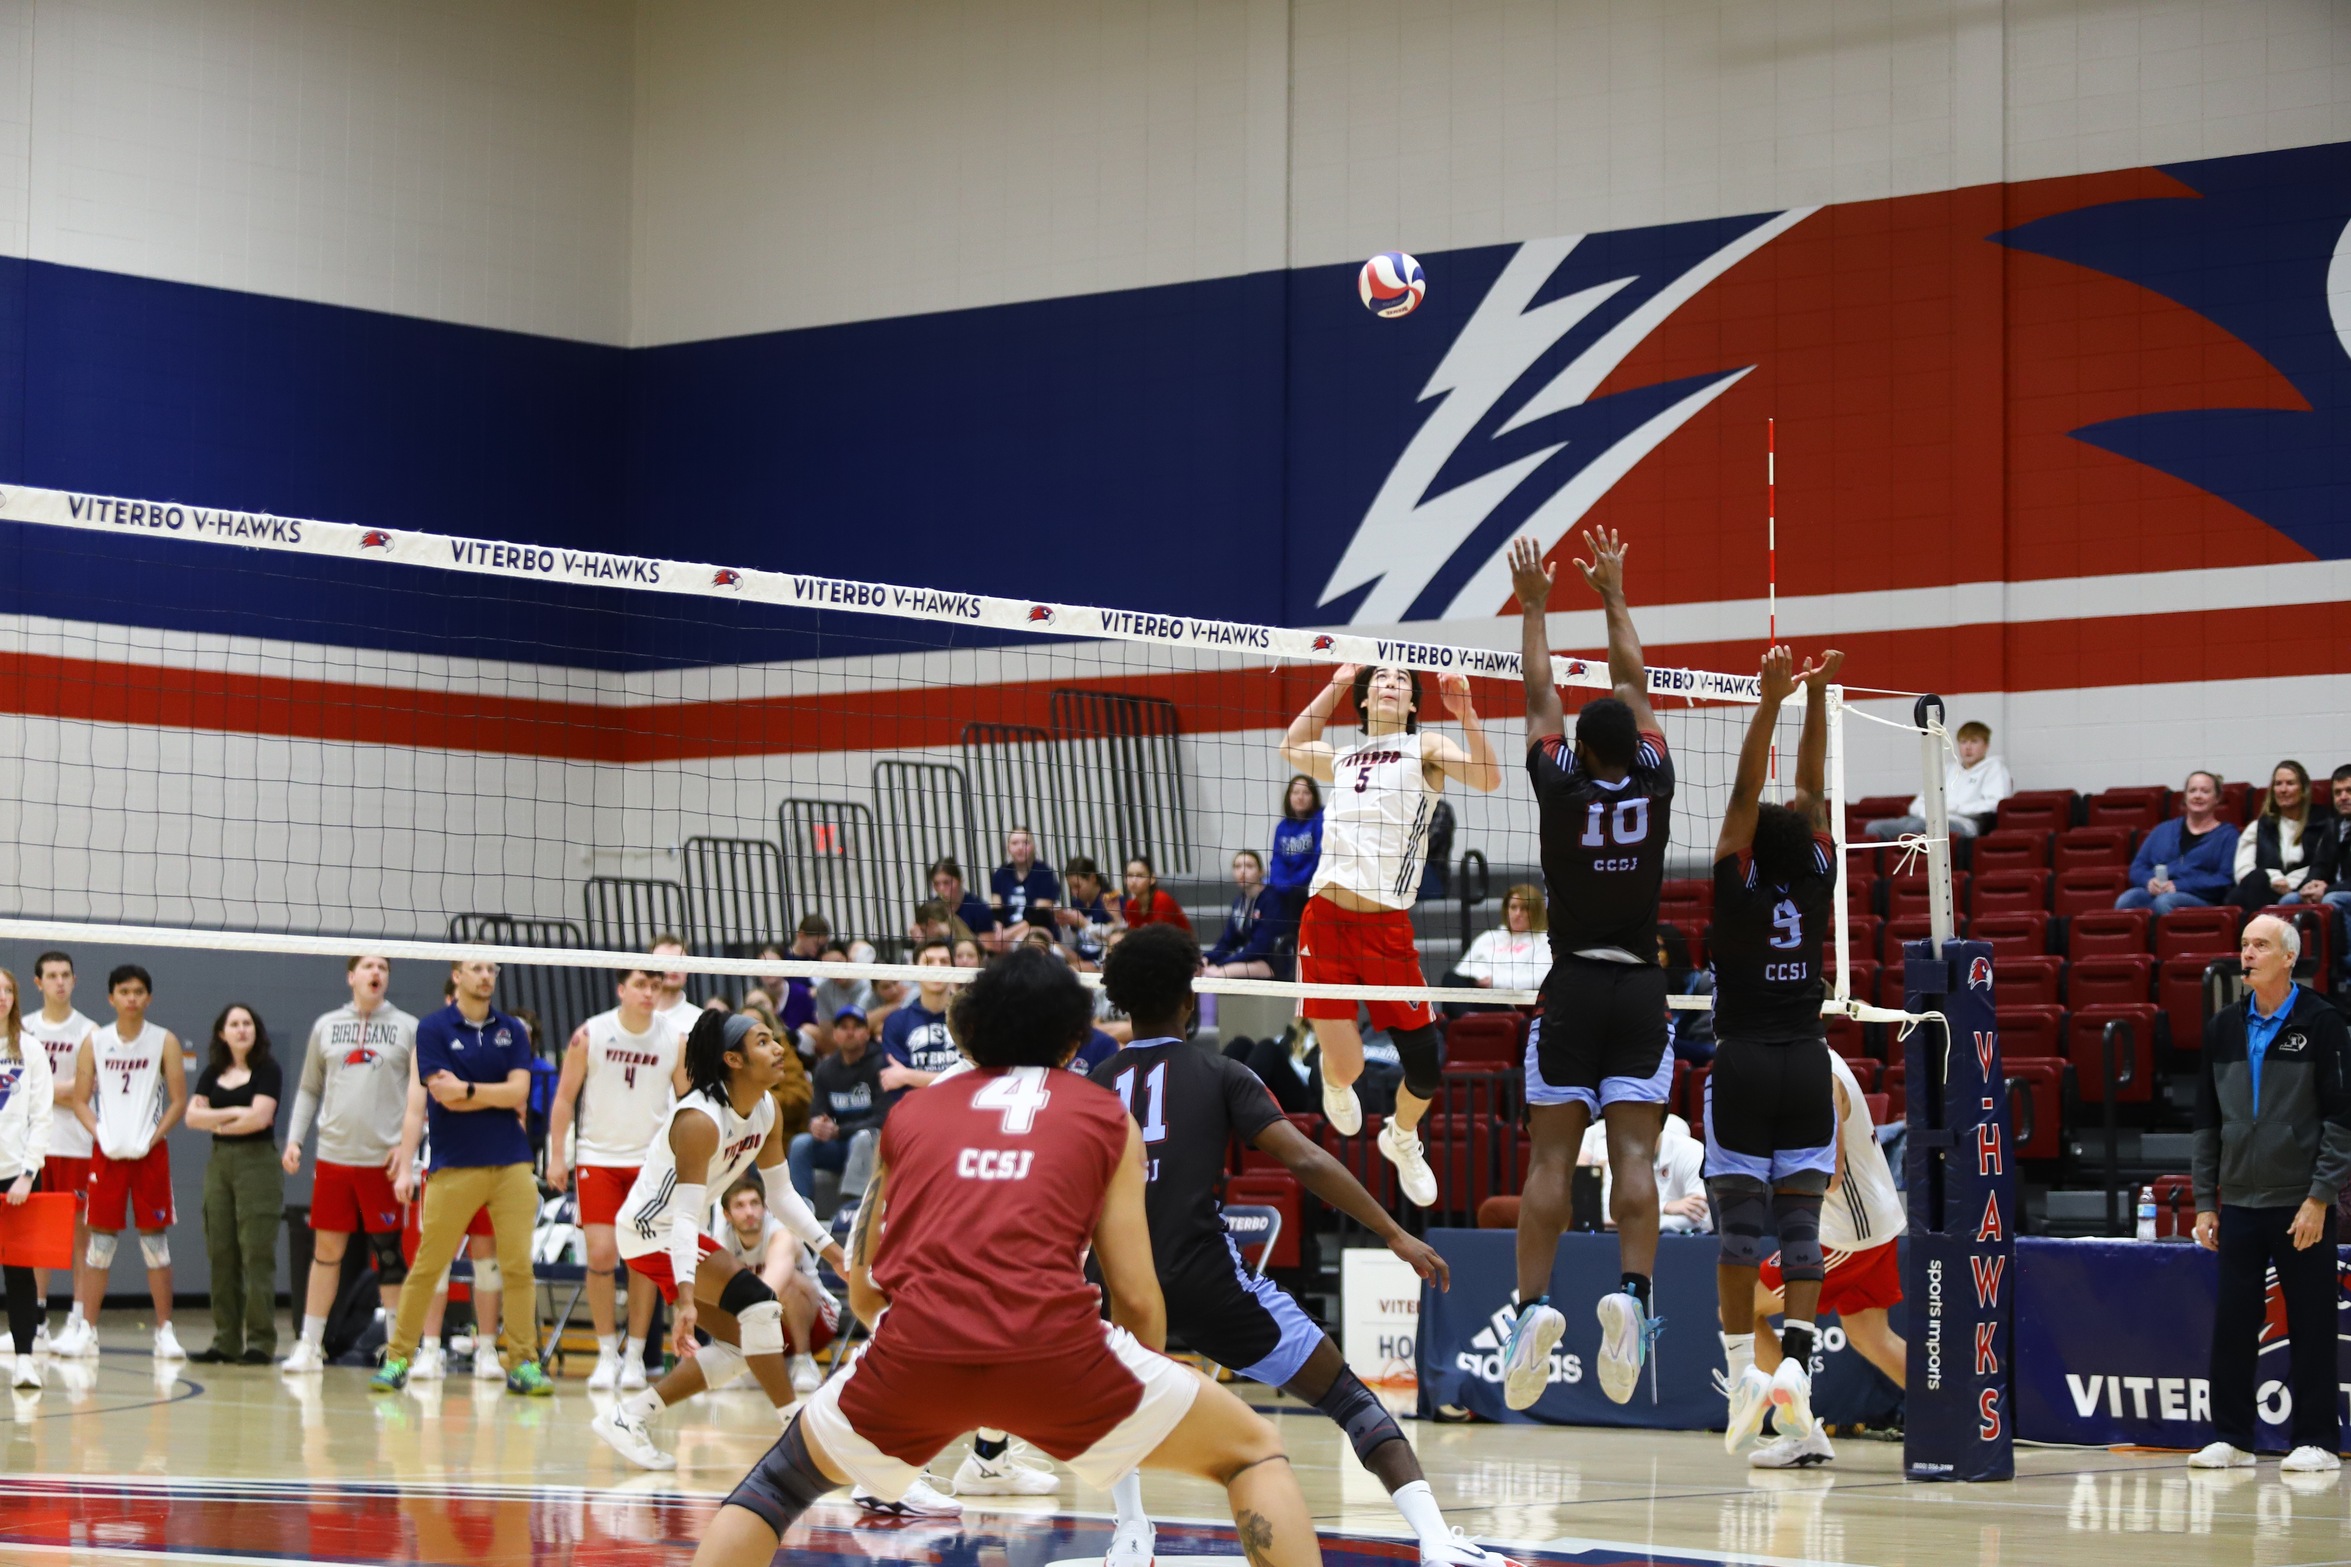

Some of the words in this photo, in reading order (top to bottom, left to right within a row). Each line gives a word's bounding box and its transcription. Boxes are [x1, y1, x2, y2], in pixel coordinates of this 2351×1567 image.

[67, 496, 184, 531] VITERBO
[193, 509, 302, 544] V-HAWKS
[449, 539, 554, 573] VITERBO
[562, 552, 661, 585] V-HAWKS
[792, 577, 886, 607] VITERBO
[892, 588, 982, 619] V-HAWKS
[1099, 609, 1184, 640] VITERBO
[1190, 622, 1270, 650] V-HAWKS
[1377, 640, 1453, 667] VITERBO
[1458, 649, 1523, 675] V-HAWK
[1646, 668, 1693, 690] TERBO
[1354, 766, 1372, 793] 5
[1580, 797, 1650, 847] 10
[1769, 898, 1803, 950] 9
[1765, 962, 1807, 981] CCSJ
[41, 1041, 73, 1053] ERBO
[331, 1024, 360, 1044] BIRD
[364, 1024, 399, 1046] GANG
[105, 1058, 149, 1072] VITERBO
[606, 1049, 660, 1066] VITERBO
[121, 1073, 130, 1094] 2
[624, 1066, 636, 1089] 4
[971, 1066, 1051, 1133] 4
[1113, 1060, 1168, 1144] 11
[957, 1149, 1034, 1180] CCSJ
[1226, 1216, 1269, 1231] TERBO
[1926, 1259, 1942, 1317] sports
[1456, 1347, 1583, 1383] adas
[1926, 1319, 1942, 1390] imports
[2065, 1373, 2293, 1426] VITERO
